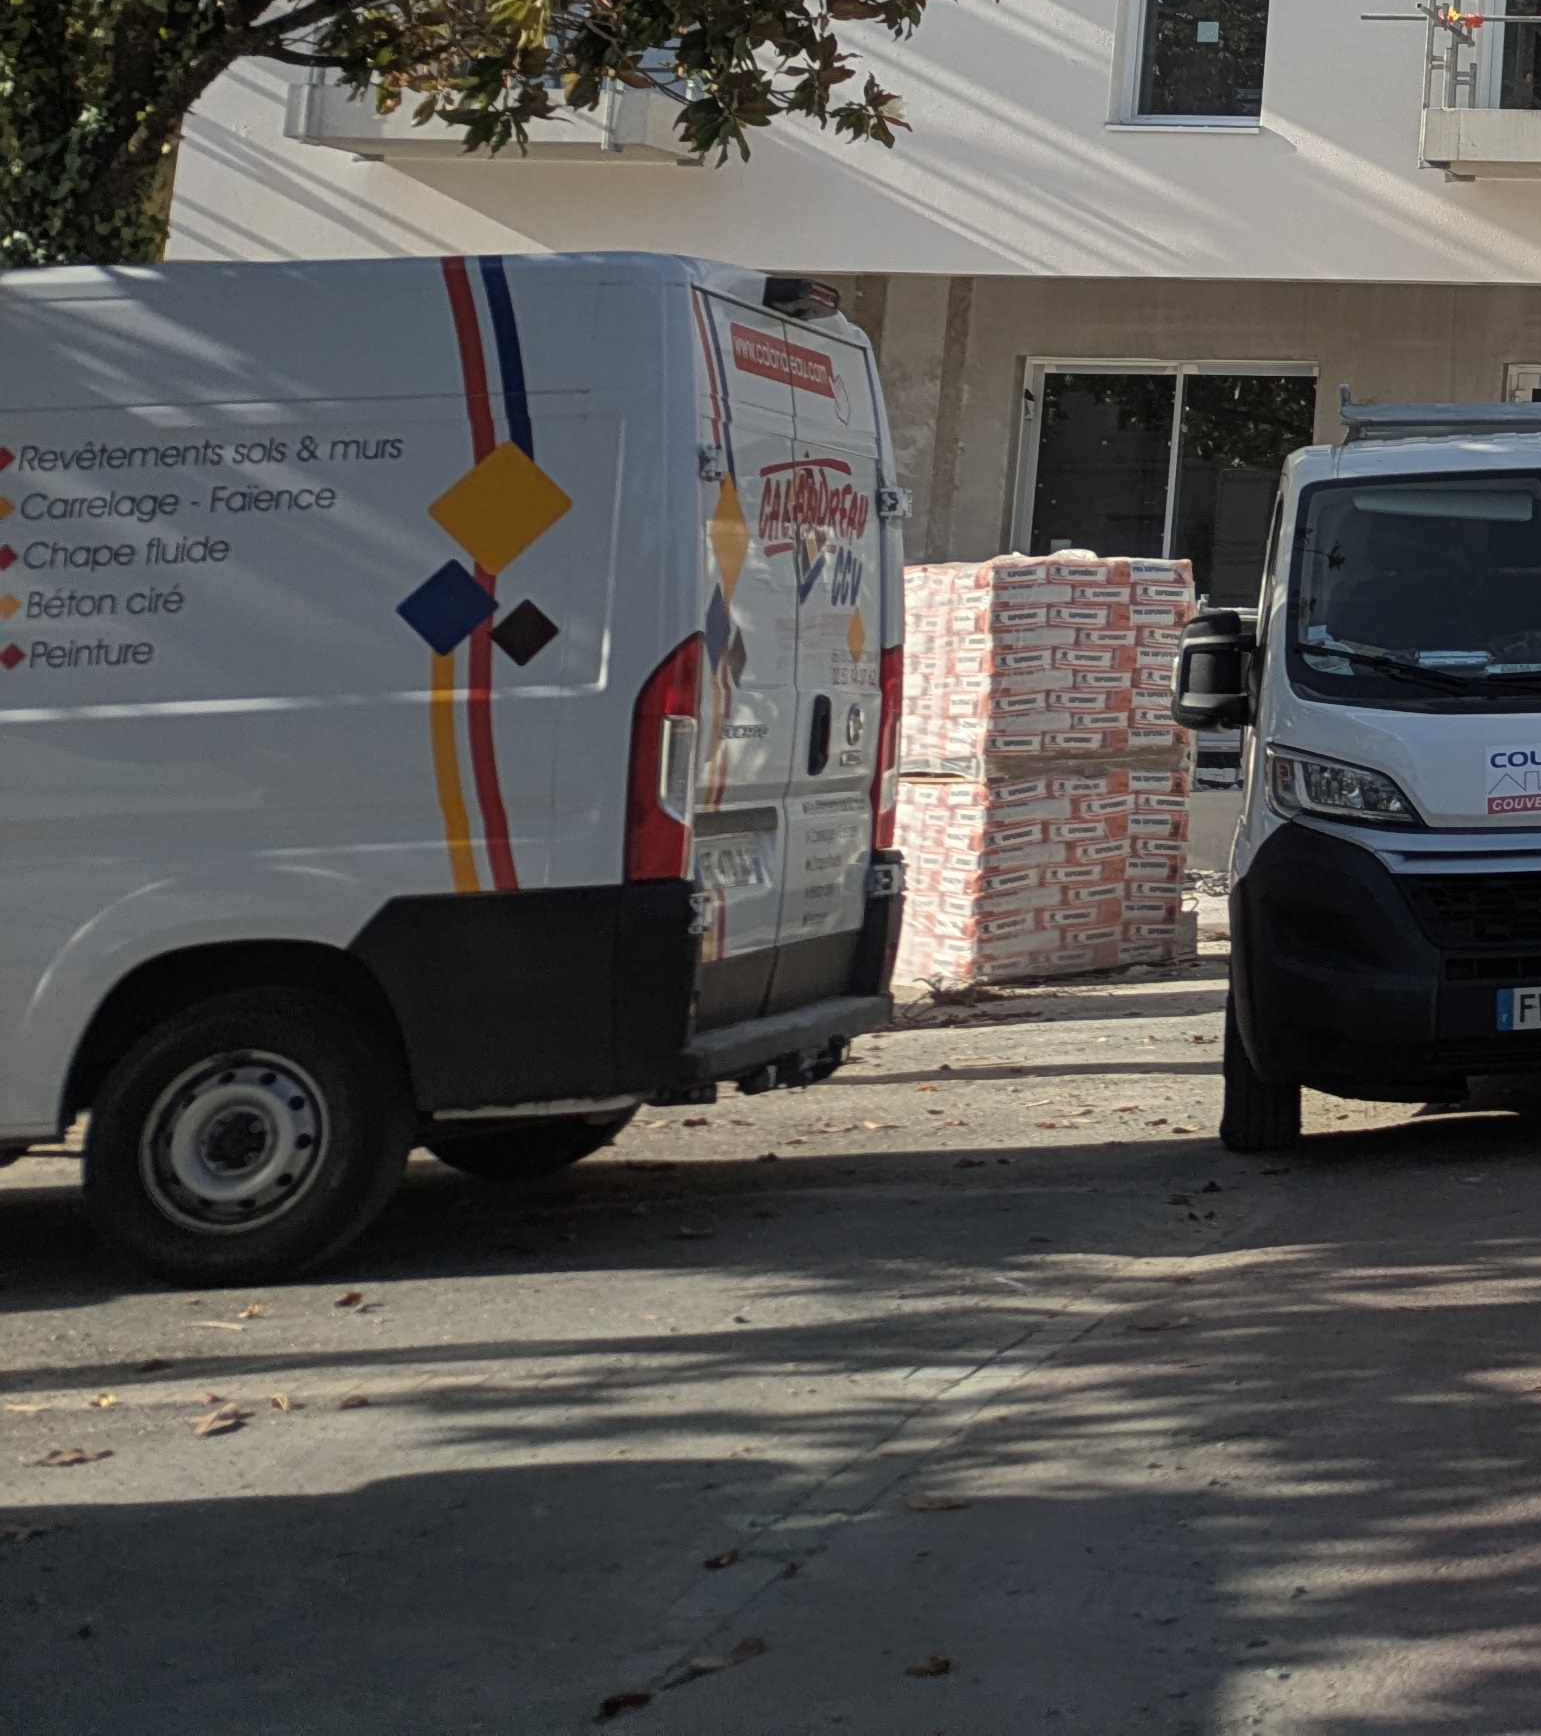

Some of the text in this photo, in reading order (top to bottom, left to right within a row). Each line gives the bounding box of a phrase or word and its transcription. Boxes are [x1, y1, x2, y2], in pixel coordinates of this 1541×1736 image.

[16, 435, 404, 472] Revêtements sols & murs
[20, 490, 181, 523] Carrelage
[209, 484, 338, 514] Faïence
[22, 536, 231, 572] Chape fluide
[25, 583, 186, 619] Béton ciré
[29, 639, 155, 669] Peinture
